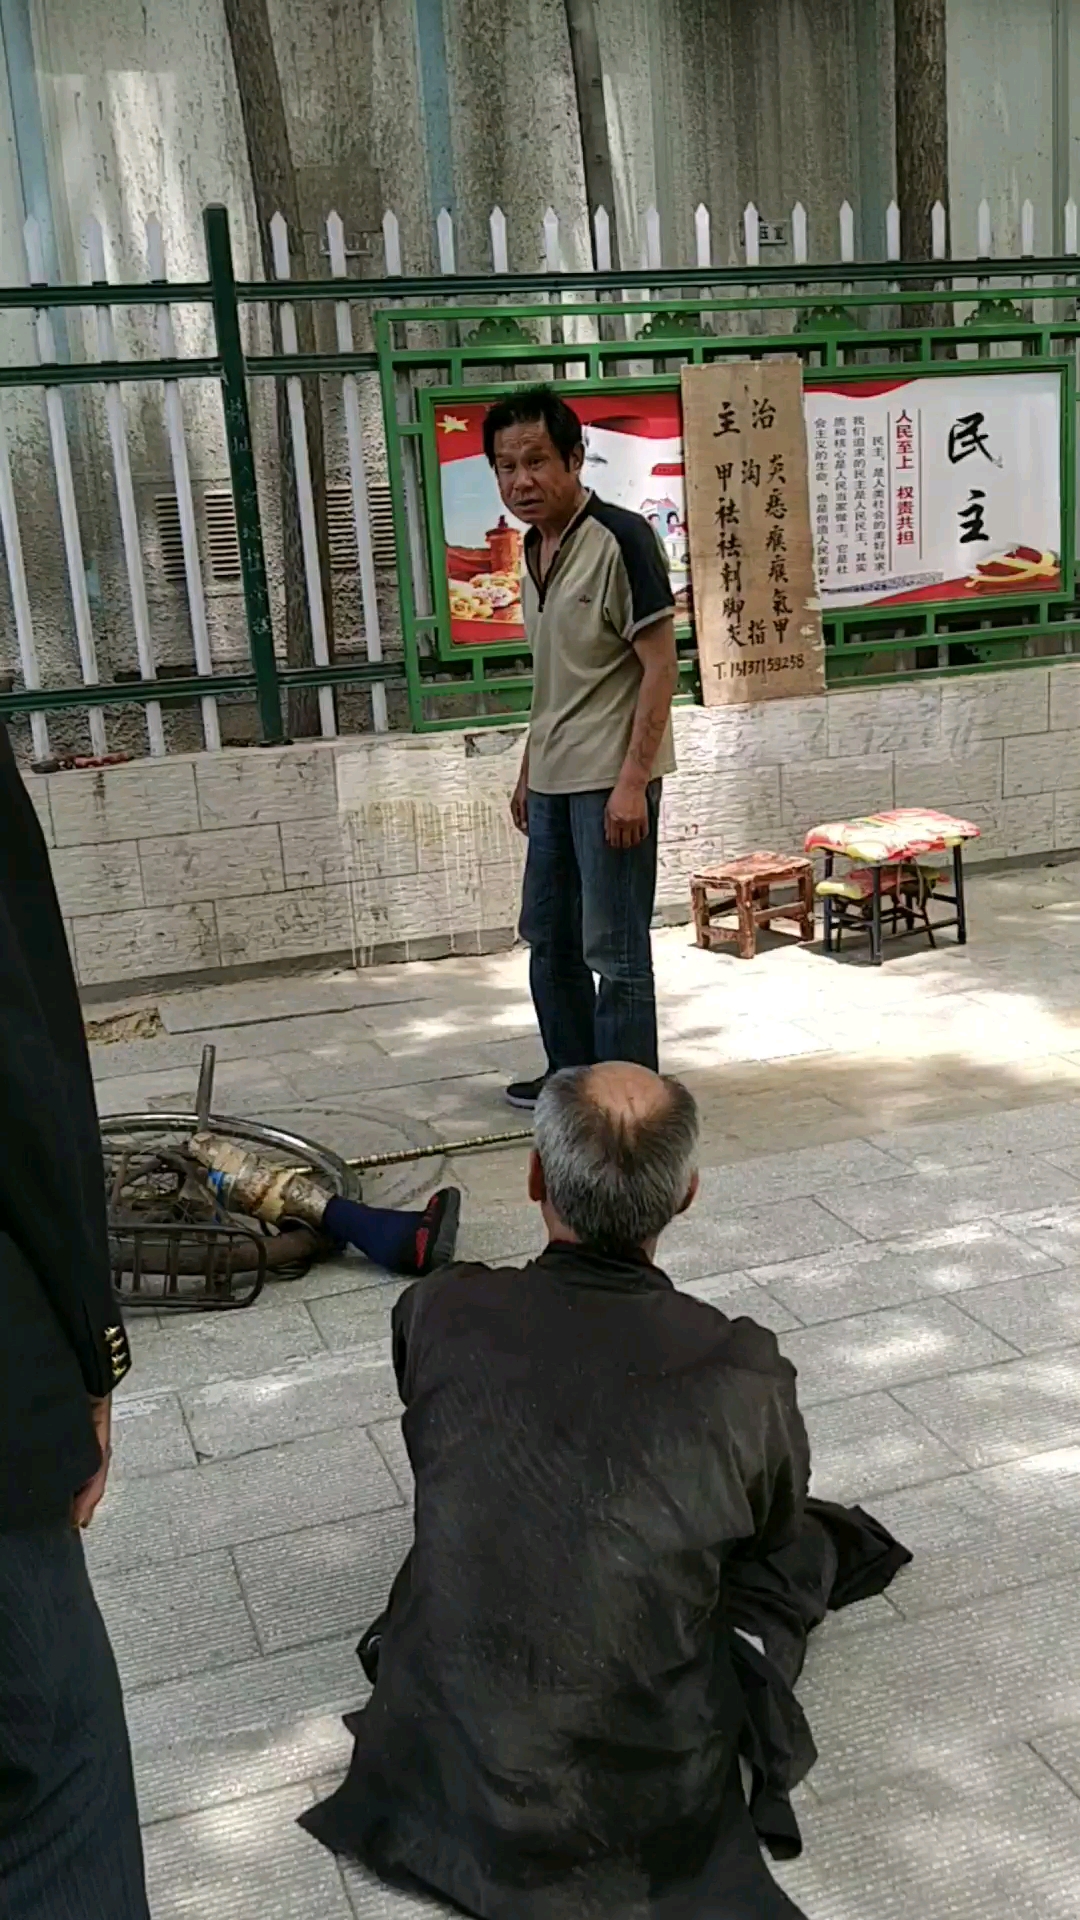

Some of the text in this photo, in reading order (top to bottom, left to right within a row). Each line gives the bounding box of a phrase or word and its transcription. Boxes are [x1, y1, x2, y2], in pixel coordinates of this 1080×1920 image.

[713, 398, 777, 438] 主治
[895, 409, 914, 545] 人民至上 权责共担
[947, 412, 996, 544] 民主
